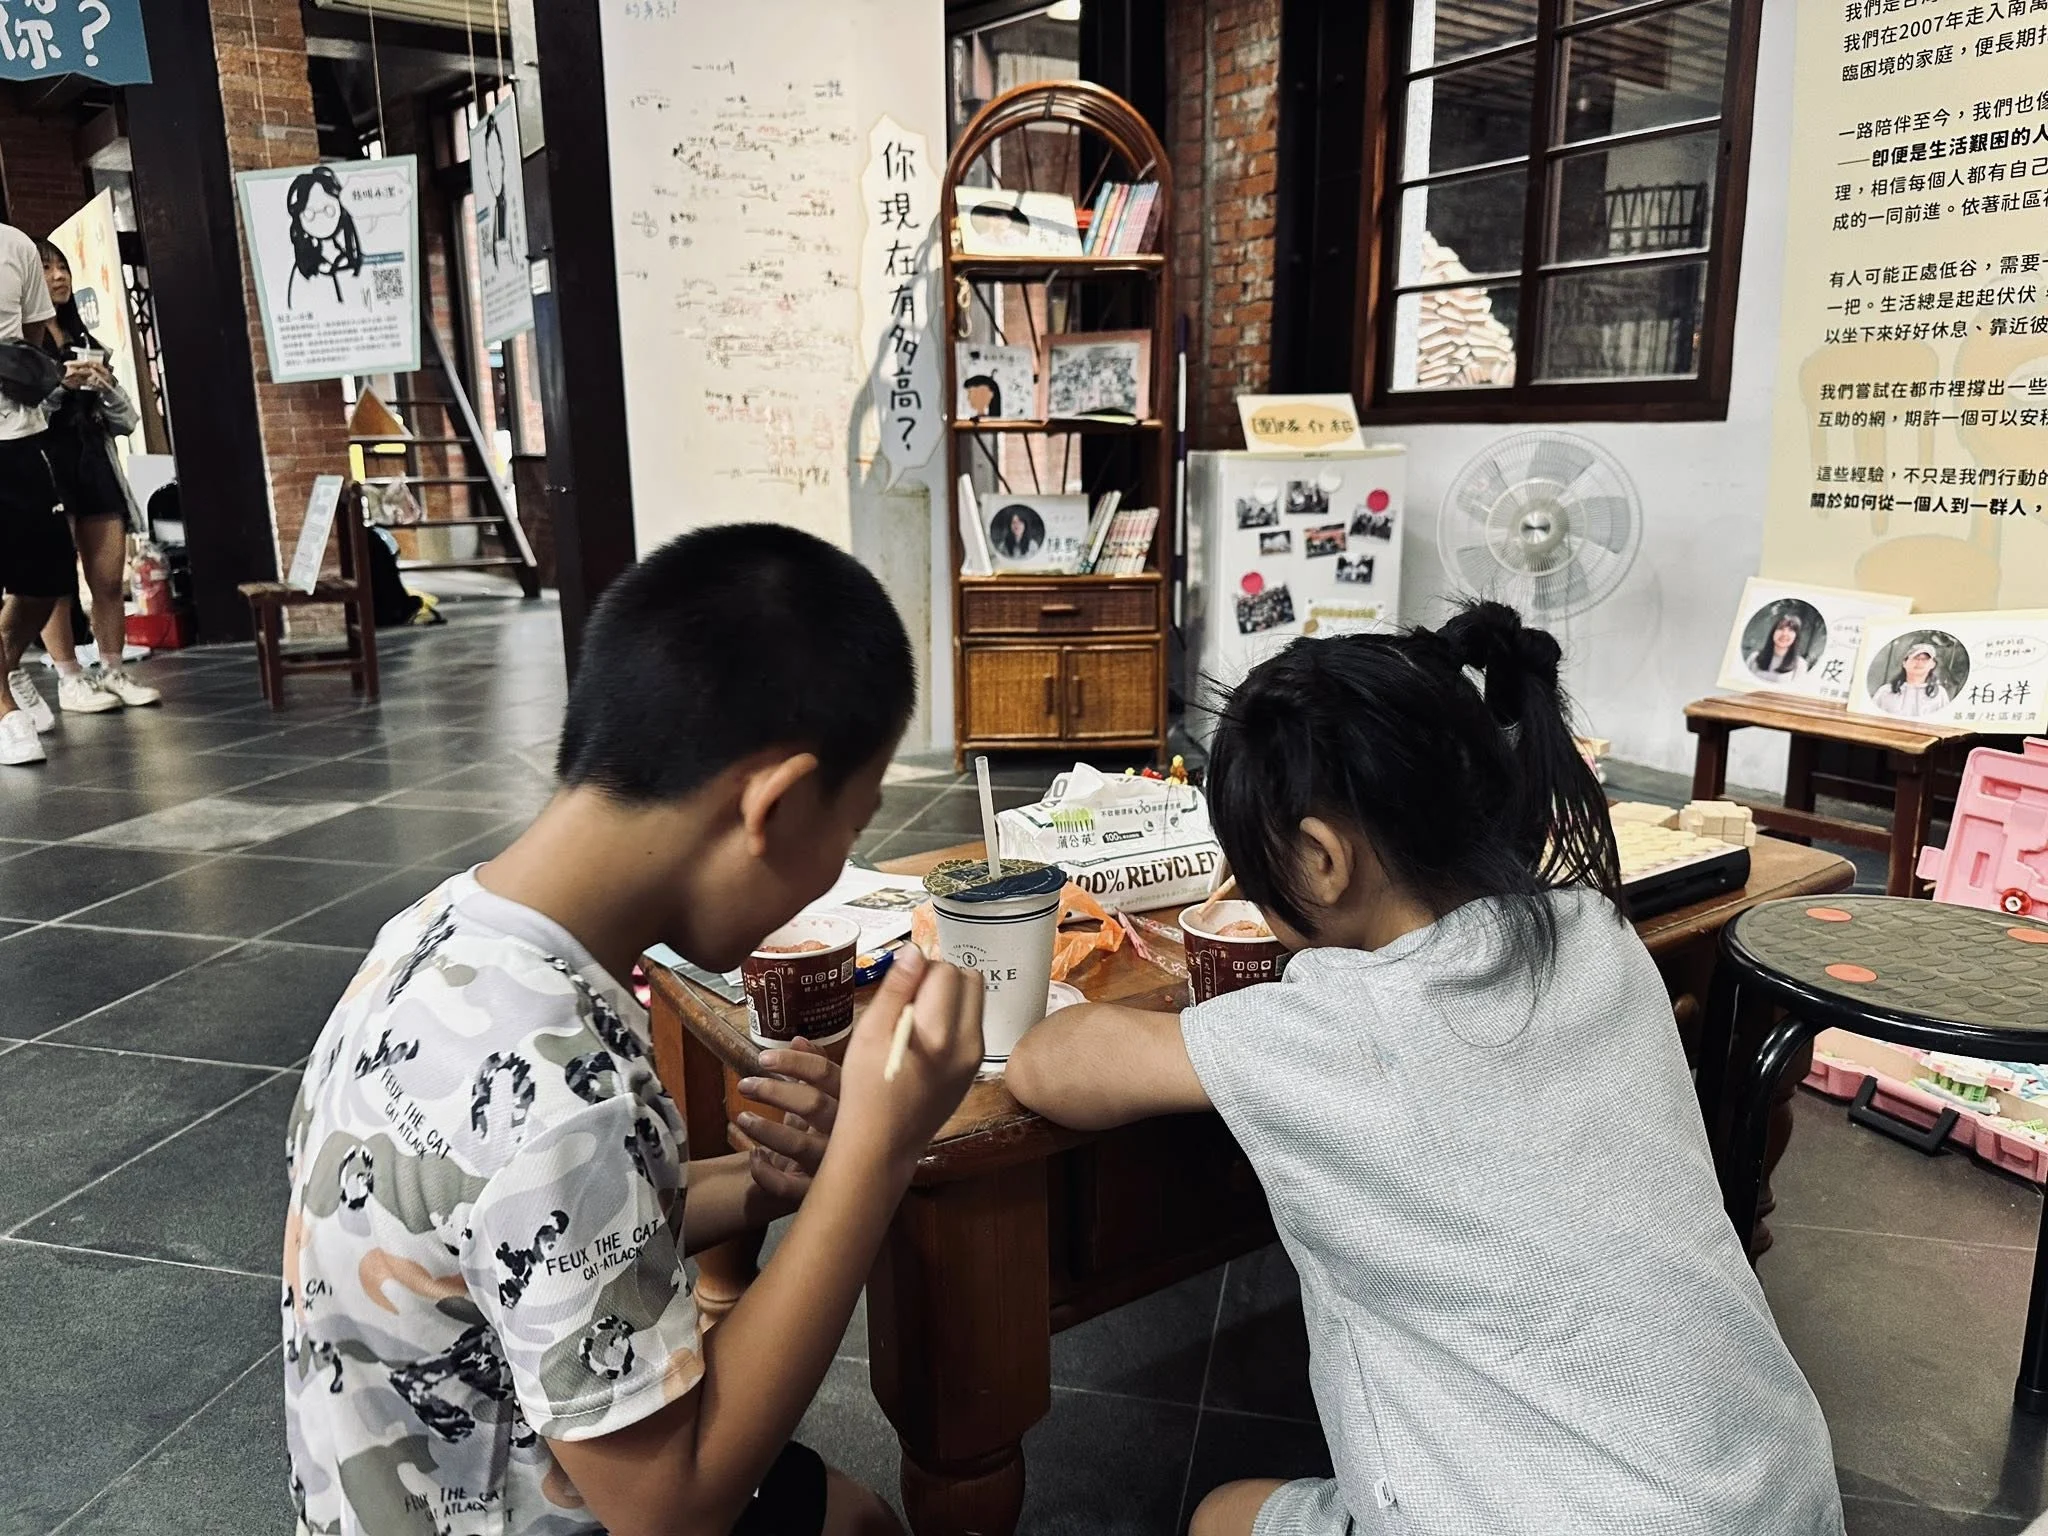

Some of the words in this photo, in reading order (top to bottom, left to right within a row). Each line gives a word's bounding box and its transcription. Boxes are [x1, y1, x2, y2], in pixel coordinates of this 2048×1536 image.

[1845, 0, 1939, 22] 我們是
[1832, 188, 2048, 231] 成的一同前進。依著社區
[878, 141, 922, 451] 你現在有多高?
[1827, 284, 2048, 316] 一把。生活總是起起伏伏
[1069, 868, 1125, 894] 00%
[404, 1101, 426, 1132] THE
[427, 1129, 452, 1160] CAT
[595, 1232, 621, 1256] THE
[633, 1219, 659, 1243] CAT
[441, 1487, 467, 1503] THE
